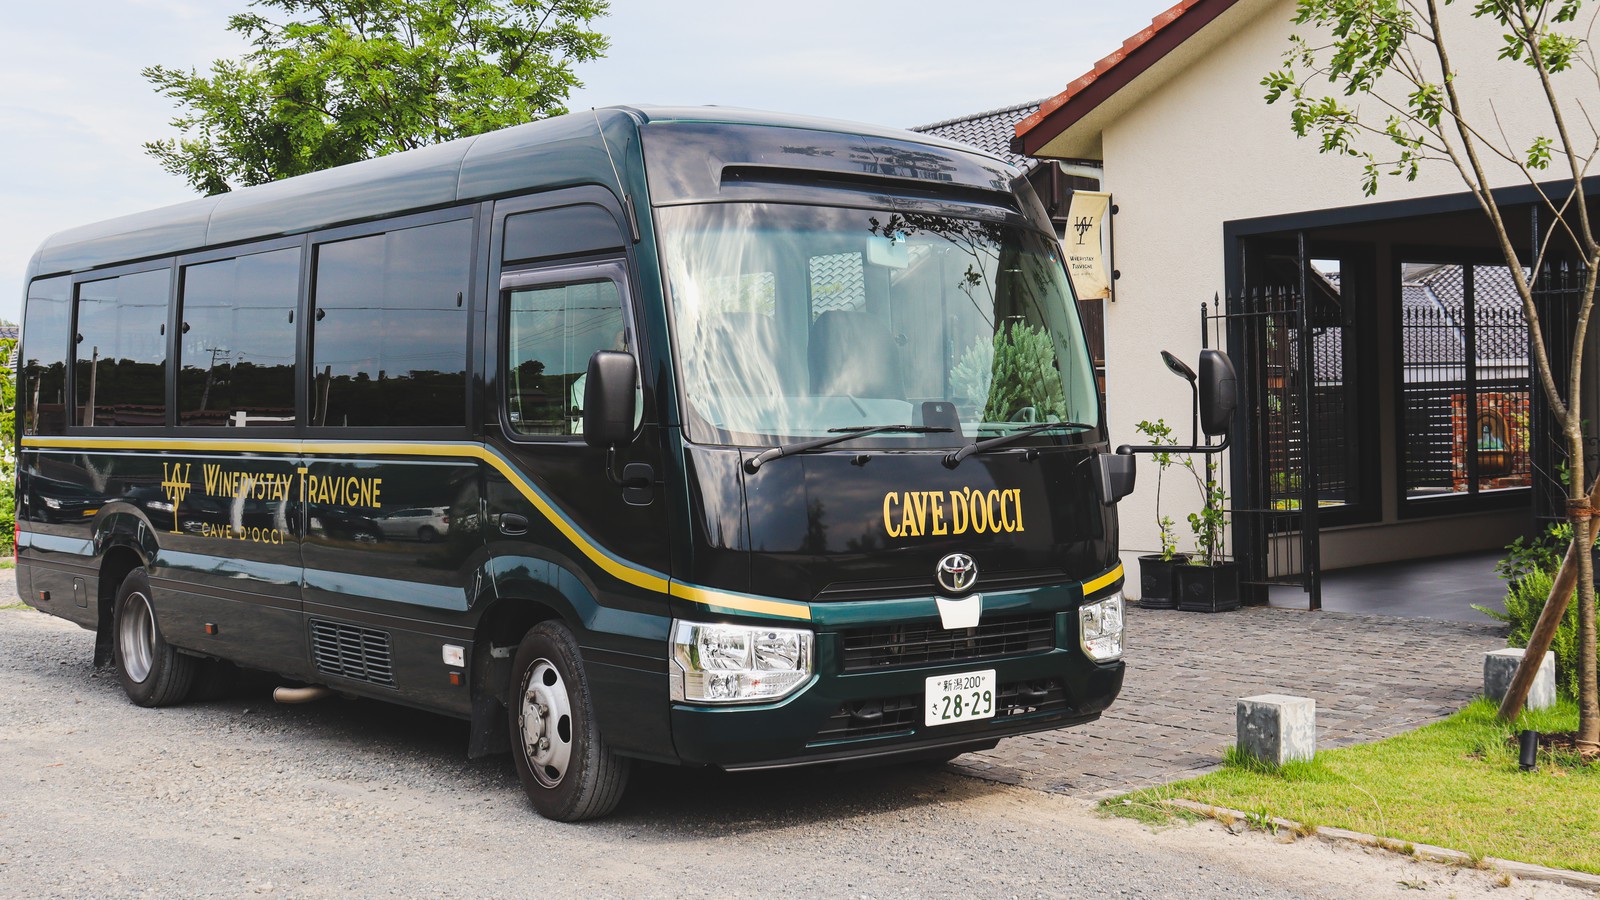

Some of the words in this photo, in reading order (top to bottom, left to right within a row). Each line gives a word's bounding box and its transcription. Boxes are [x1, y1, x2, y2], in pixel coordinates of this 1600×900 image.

[203, 463, 293, 500] WINERYSTAY
[297, 467, 382, 508] TRAVIGNE
[883, 491, 947, 538] CAVE
[949, 486, 1025, 534] D'OCCI
[201, 522, 233, 540] CAVE
[239, 525, 285, 545] D'OCCI
[932, 703, 938, 716] さ
[941, 690, 992, 720] 28-29
